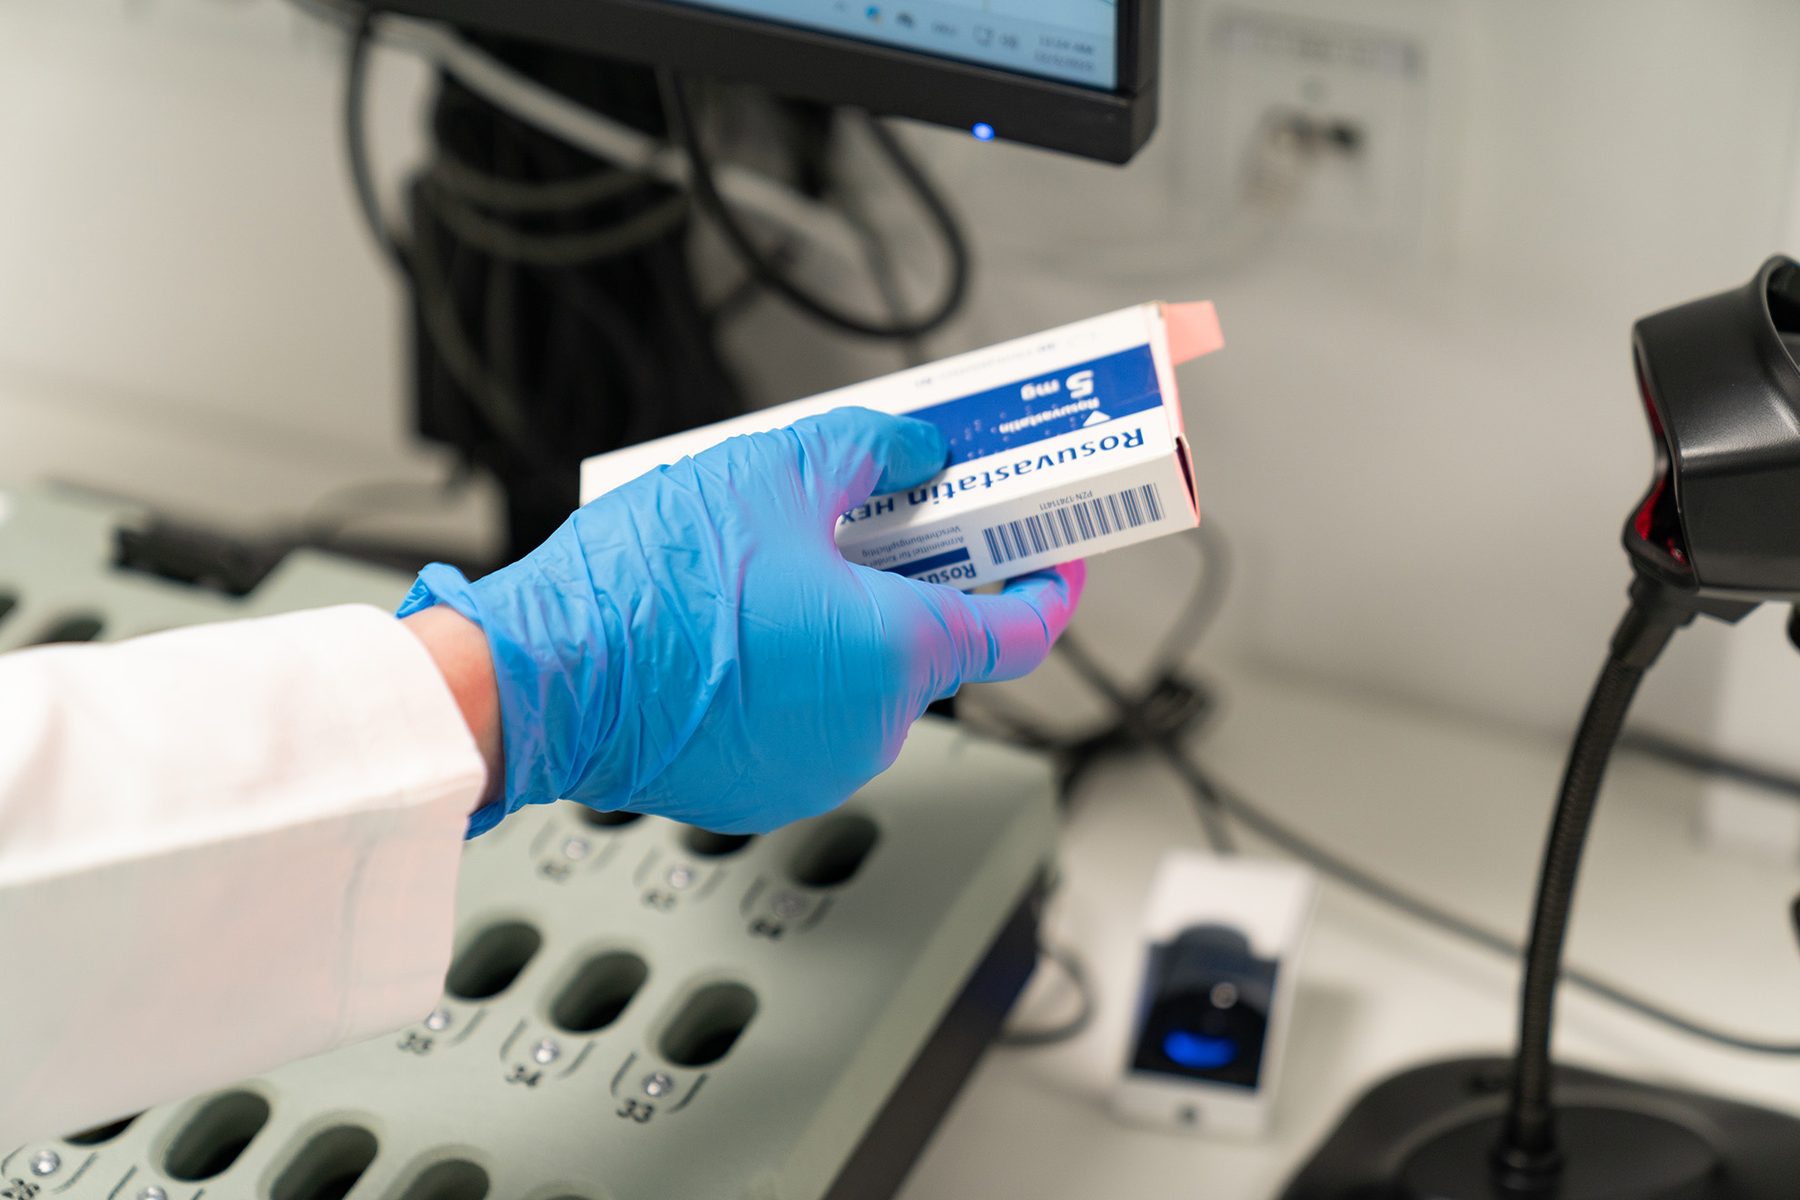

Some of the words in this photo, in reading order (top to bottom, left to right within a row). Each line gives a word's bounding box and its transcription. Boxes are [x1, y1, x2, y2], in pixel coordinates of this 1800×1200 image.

[1020, 378, 1060, 401] mg
[1065, 369, 1094, 399] 5
[998, 396, 1100, 434] Rosuvastatin
[907, 427, 1145, 506] Rosuvastatin
[861, 525, 961, 557] Verschreibungspflichtig
[912, 536, 964, 557] Arzneimittel
[505, 1064, 542, 1087] 34
[616, 1099, 654, 1123] 33
